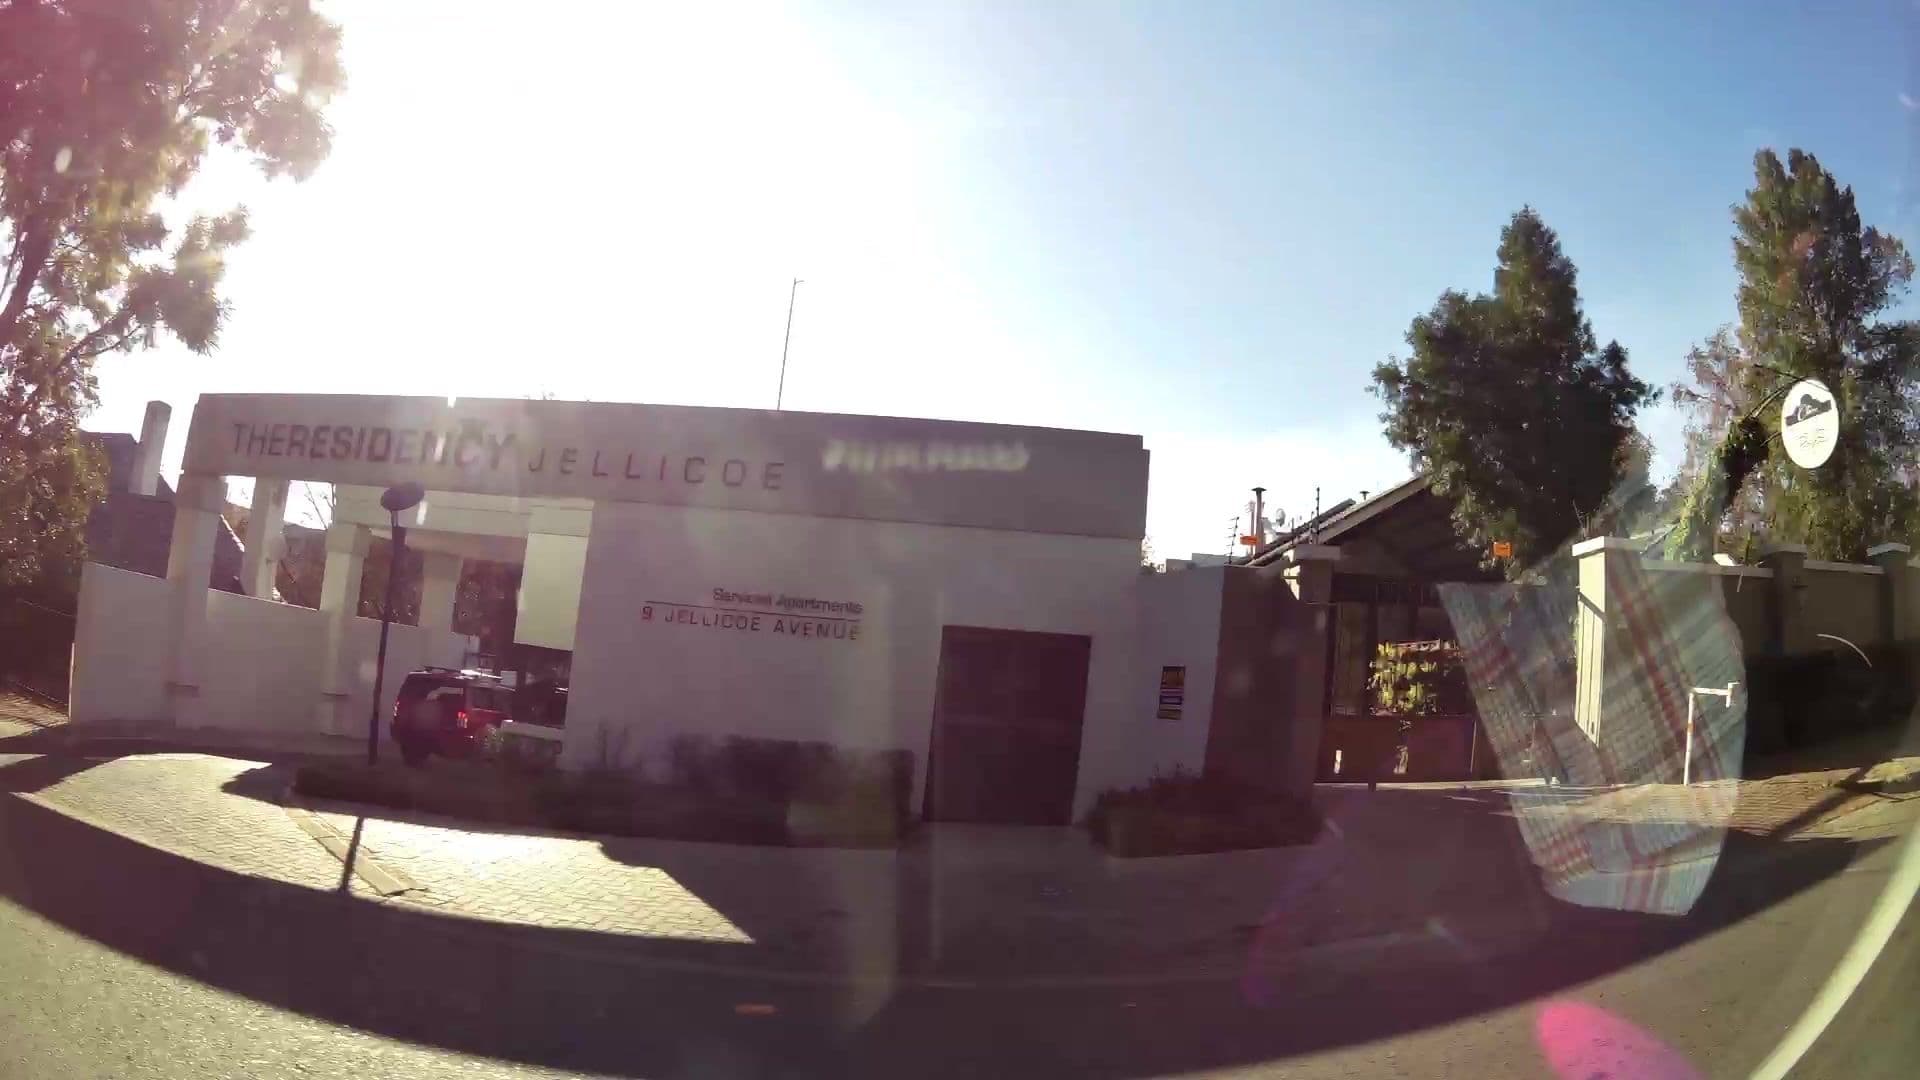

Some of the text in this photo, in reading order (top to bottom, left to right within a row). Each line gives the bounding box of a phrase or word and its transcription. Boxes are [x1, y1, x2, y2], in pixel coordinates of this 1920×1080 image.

[528, 447, 785, 490] JELLICOE
[641, 606, 861, 640] 9 JELLICOE AVENUE
